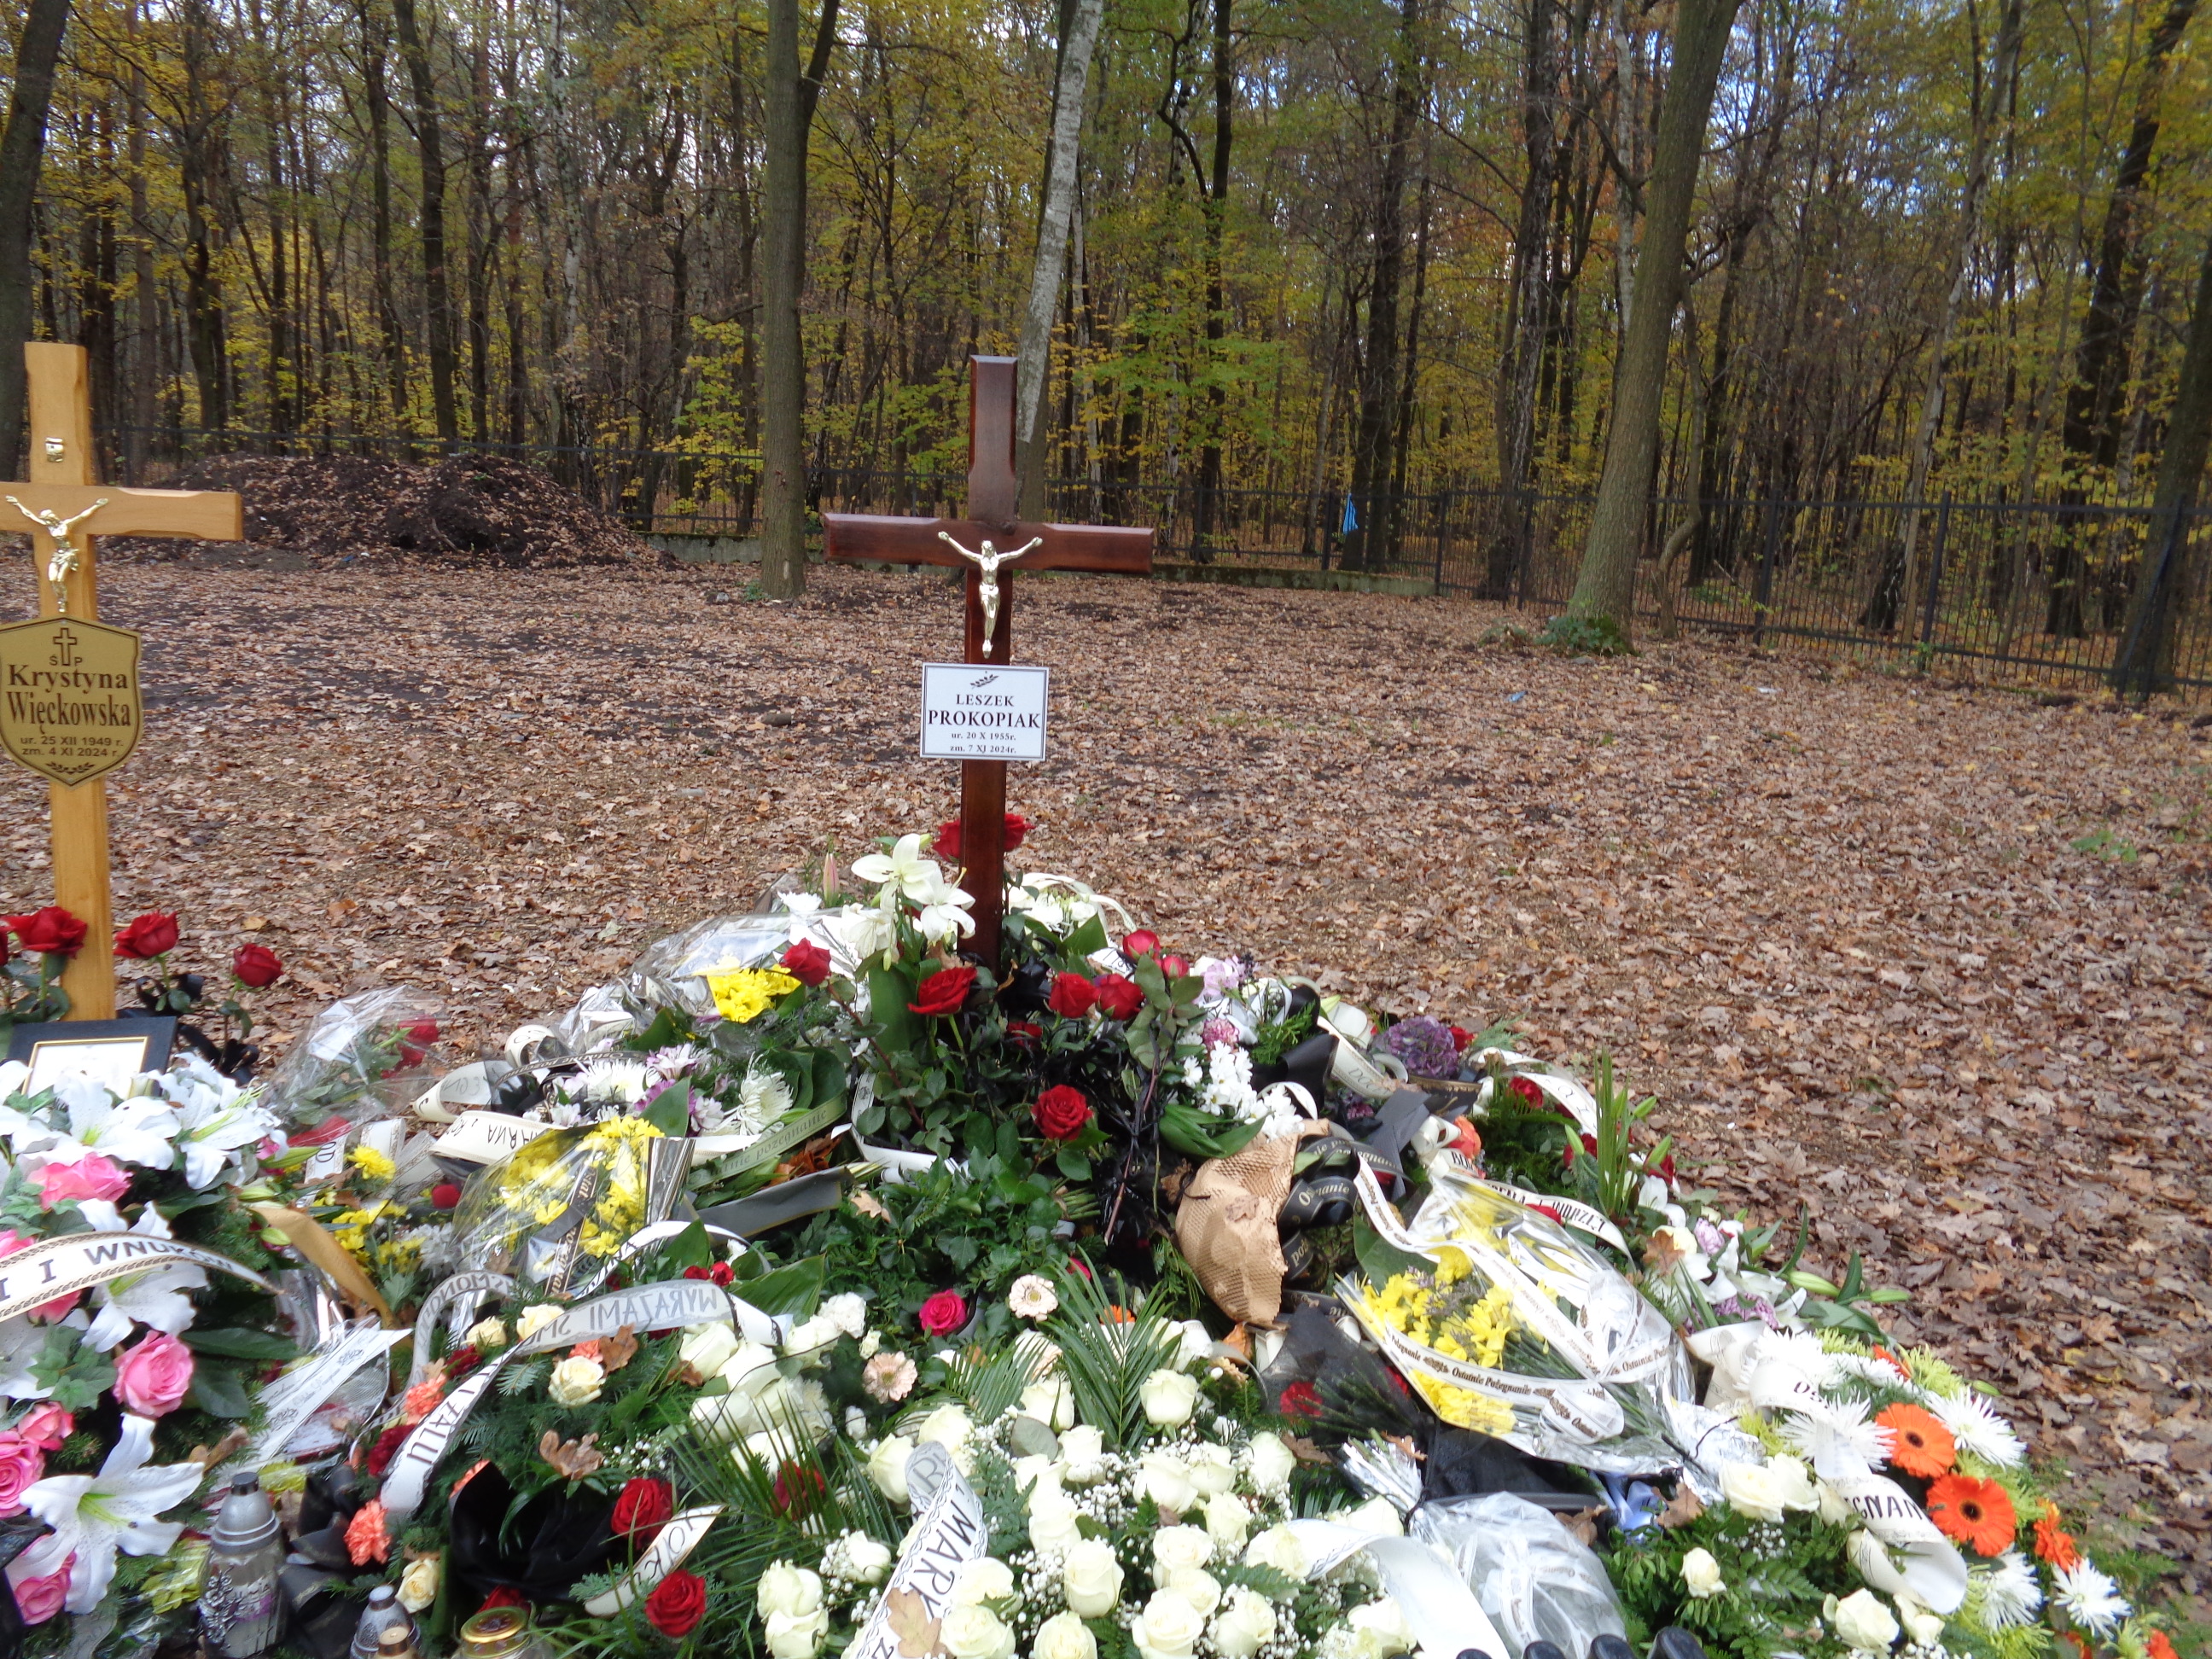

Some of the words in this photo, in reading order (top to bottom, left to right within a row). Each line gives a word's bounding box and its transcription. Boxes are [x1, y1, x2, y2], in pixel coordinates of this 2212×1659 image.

[7, 664, 128, 693] Krystyna
[956, 694, 1015, 707] LESZEK
[7, 691, 131, 735] Więckowska
[928, 709, 1041, 729] PROKOPIAK
[20, 737, 37, 746] ur.
[41, 736, 55, 746] 25
[61, 736, 77, 746] XII
[82, 737, 111, 746] 1949
[966, 731, 976, 740] 20
[49, 748, 57, 756] 4
[61, 748, 73, 756] XI
[77, 748, 108, 757] 2024
[38, 1259, 56, 1284] I
[1452, 1367, 1485, 1384] Ostatnie
